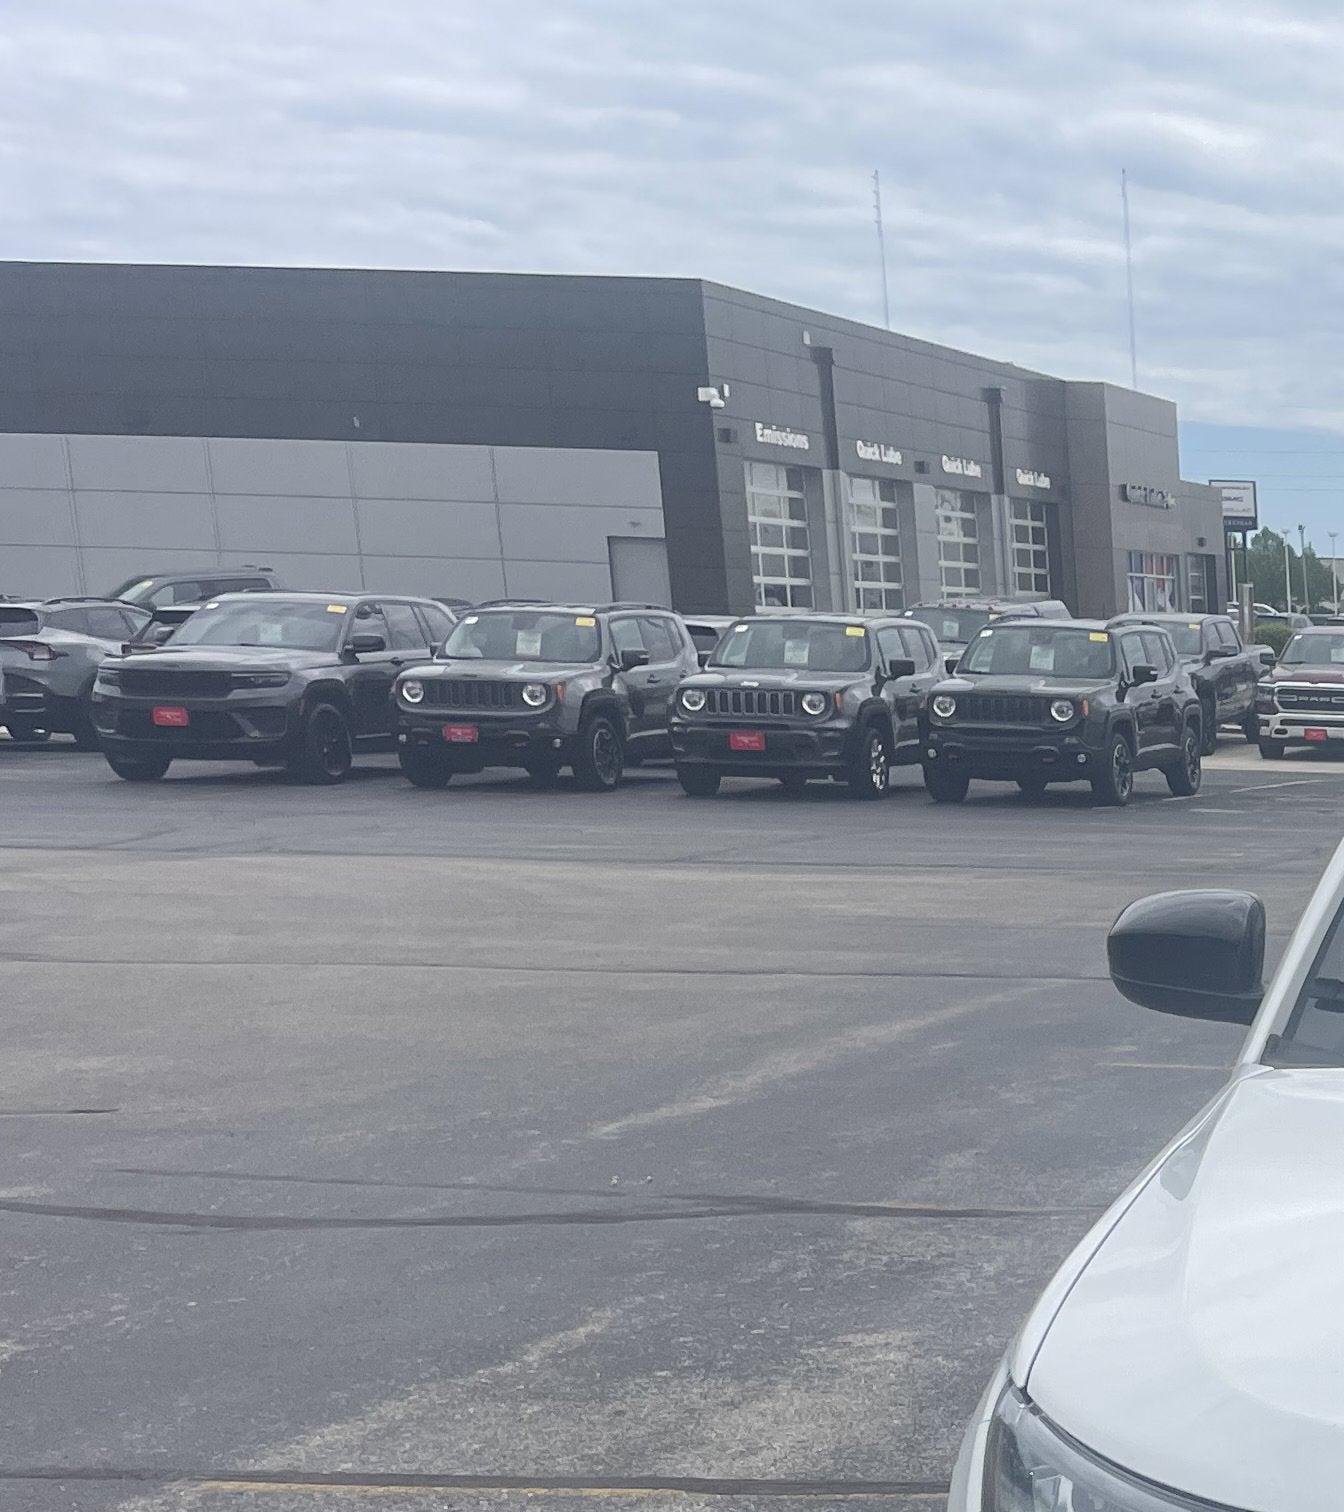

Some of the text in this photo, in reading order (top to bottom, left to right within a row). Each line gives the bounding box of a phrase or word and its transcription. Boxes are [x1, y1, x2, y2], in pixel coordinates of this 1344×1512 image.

[755, 422, 809, 450] Emissions
[856, 440, 902, 465] Quick Lube
